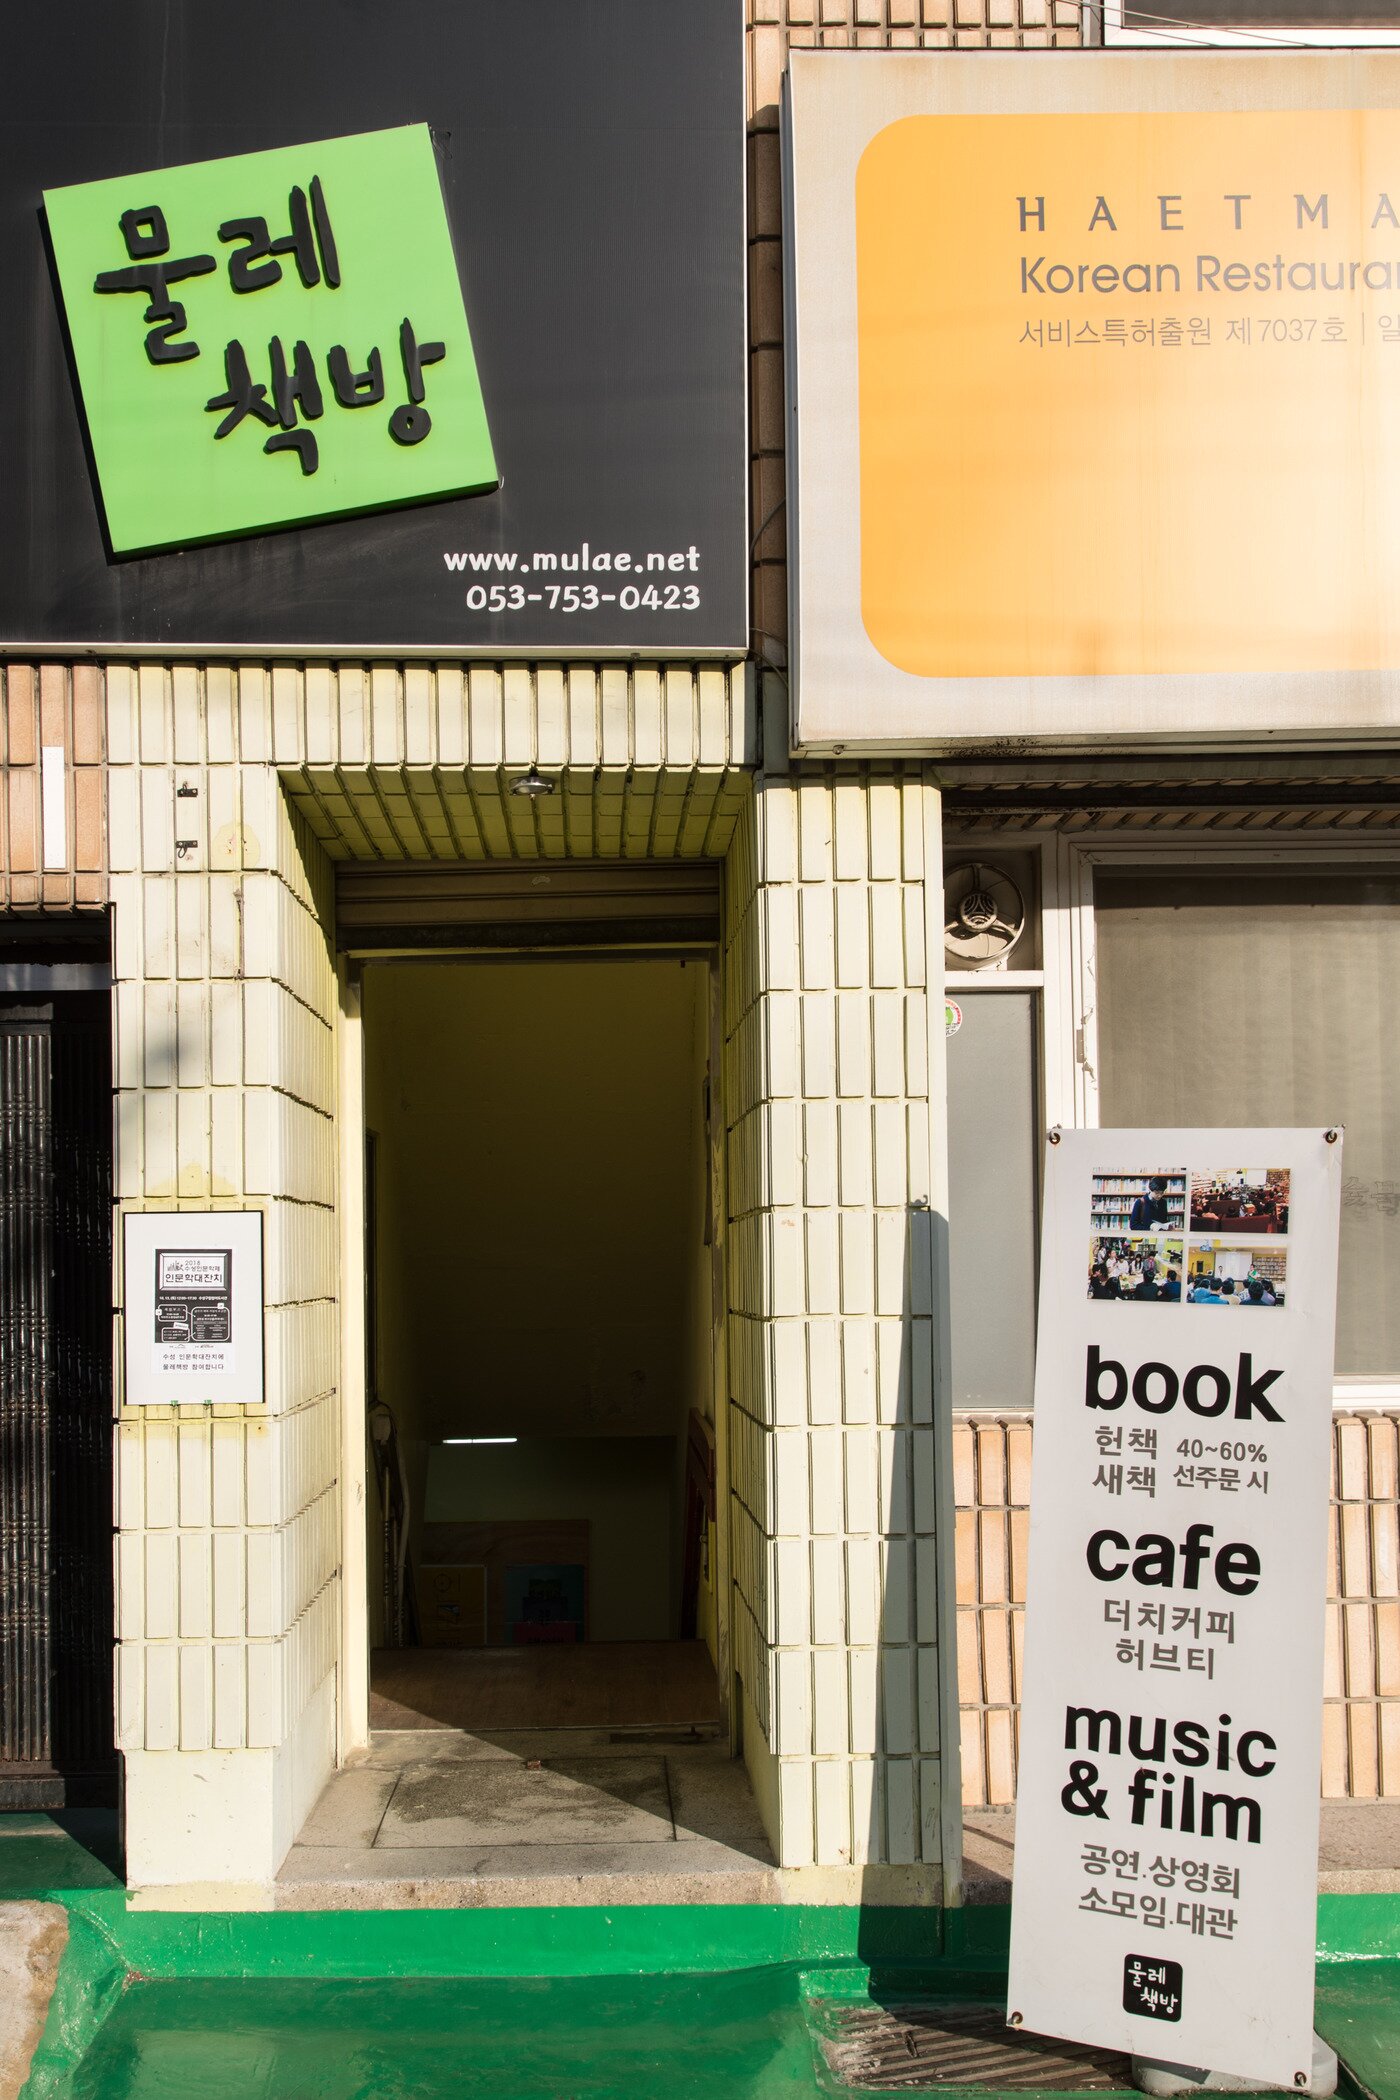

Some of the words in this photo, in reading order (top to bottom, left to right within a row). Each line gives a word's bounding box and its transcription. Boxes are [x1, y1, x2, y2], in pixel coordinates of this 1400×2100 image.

[1016, 192, 1400, 232] HAETMA
[94, 174, 341, 366] 물레
[1020, 256, 1181, 294] Korean
[1197, 254, 1400, 292] Restaura
[1019, 317, 1212, 348] 서비스특허출원
[205, 318, 445, 476] 책방
[444, 543, 700, 573] www.mulae.net
[467, 585, 700, 612] 053-753-0423
[165, 1273, 222, 1283] 인문학대잔치
[1086, 1345, 1285, 1422] book
[1177, 1439, 1267, 1462] 40~60%
[1092, 1464, 1155, 1498] 새책
[1173, 1465, 1240, 1491] 선주문
[1247, 1471, 1268, 1494] 시
[1087, 1524, 1260, 1595] cafe
[1105, 1600, 1234, 1643] 더치커피
[1116, 1639, 1214, 1679] 허브티
[1065, 1706, 1276, 1777] music
[1061, 1759, 1110, 1820] &
[1129, 1769, 1260, 1843] film
[1128, 1962, 1165, 1987] 물레
[1141, 1987, 1178, 2013] 책방
